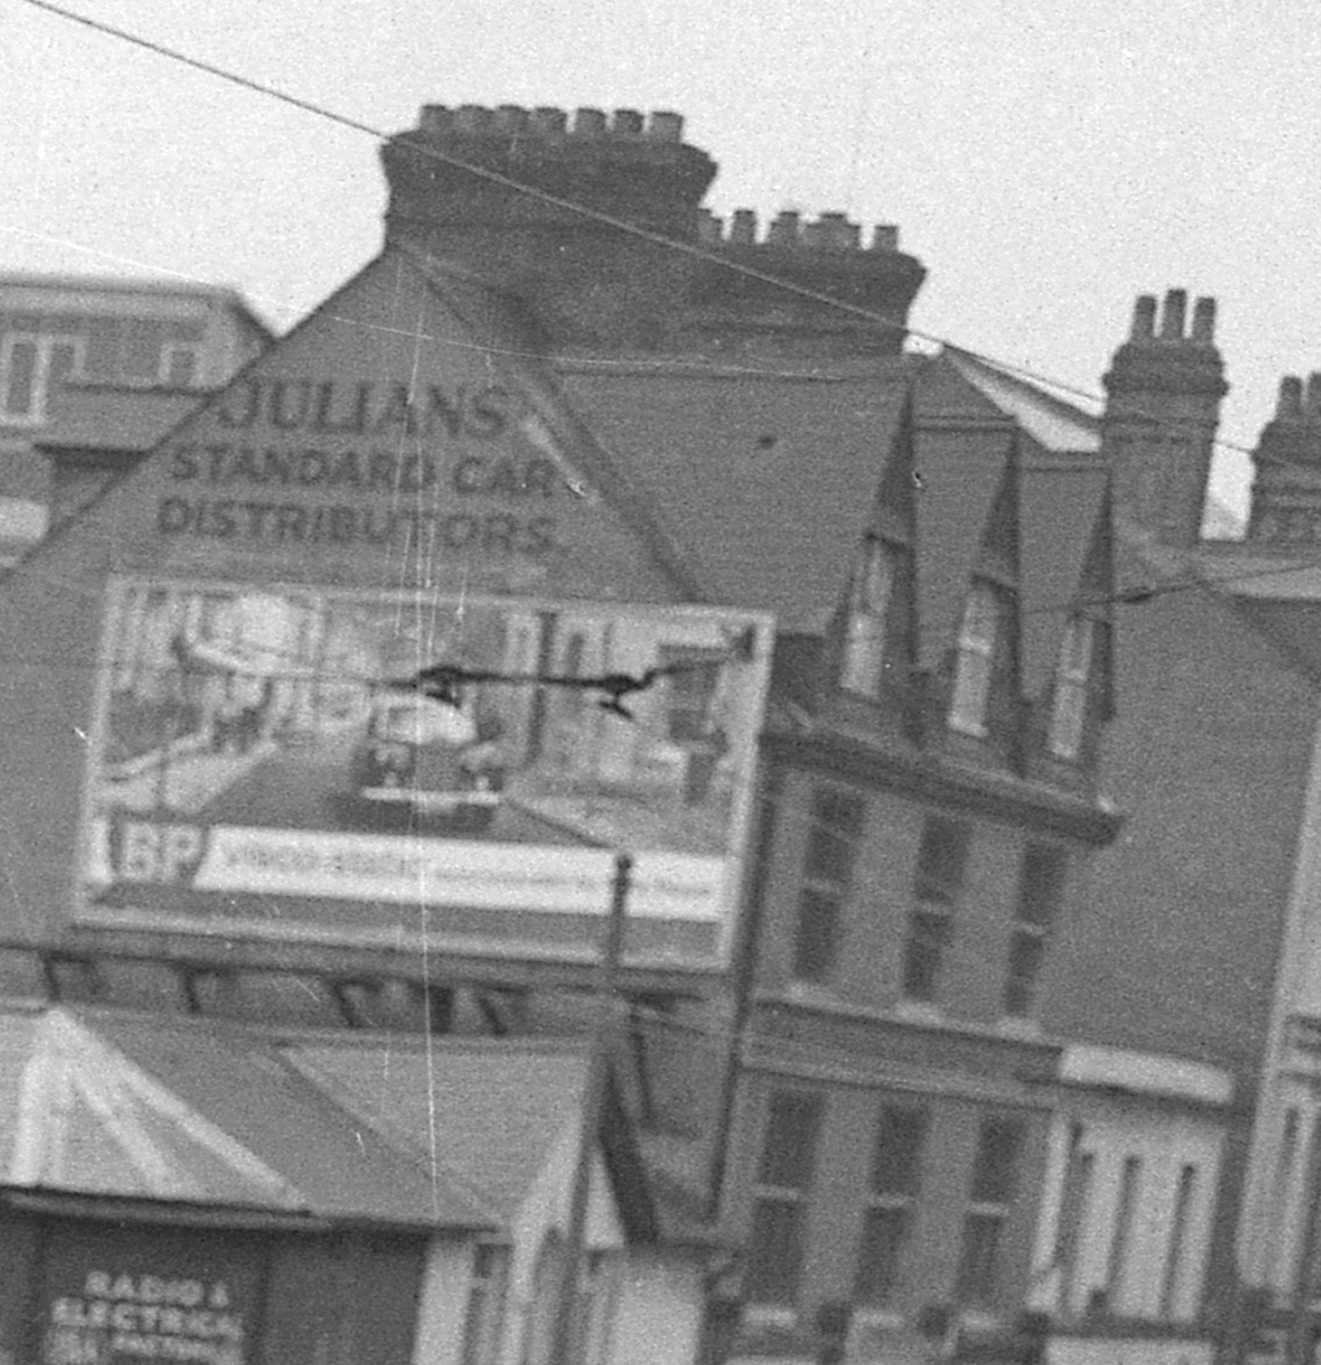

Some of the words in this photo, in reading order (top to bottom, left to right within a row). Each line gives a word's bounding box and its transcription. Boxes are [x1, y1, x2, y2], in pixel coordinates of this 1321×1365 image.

[218, 380, 511, 440] JULIANS
[171, 446, 437, 493] STANDARD
[453, 457, 555, 501] CAR
[161, 496, 553, 556] DISTRIBUTORS
[118, 826, 200, 882] BP
[85, 1269, 203, 1307] RADIO
